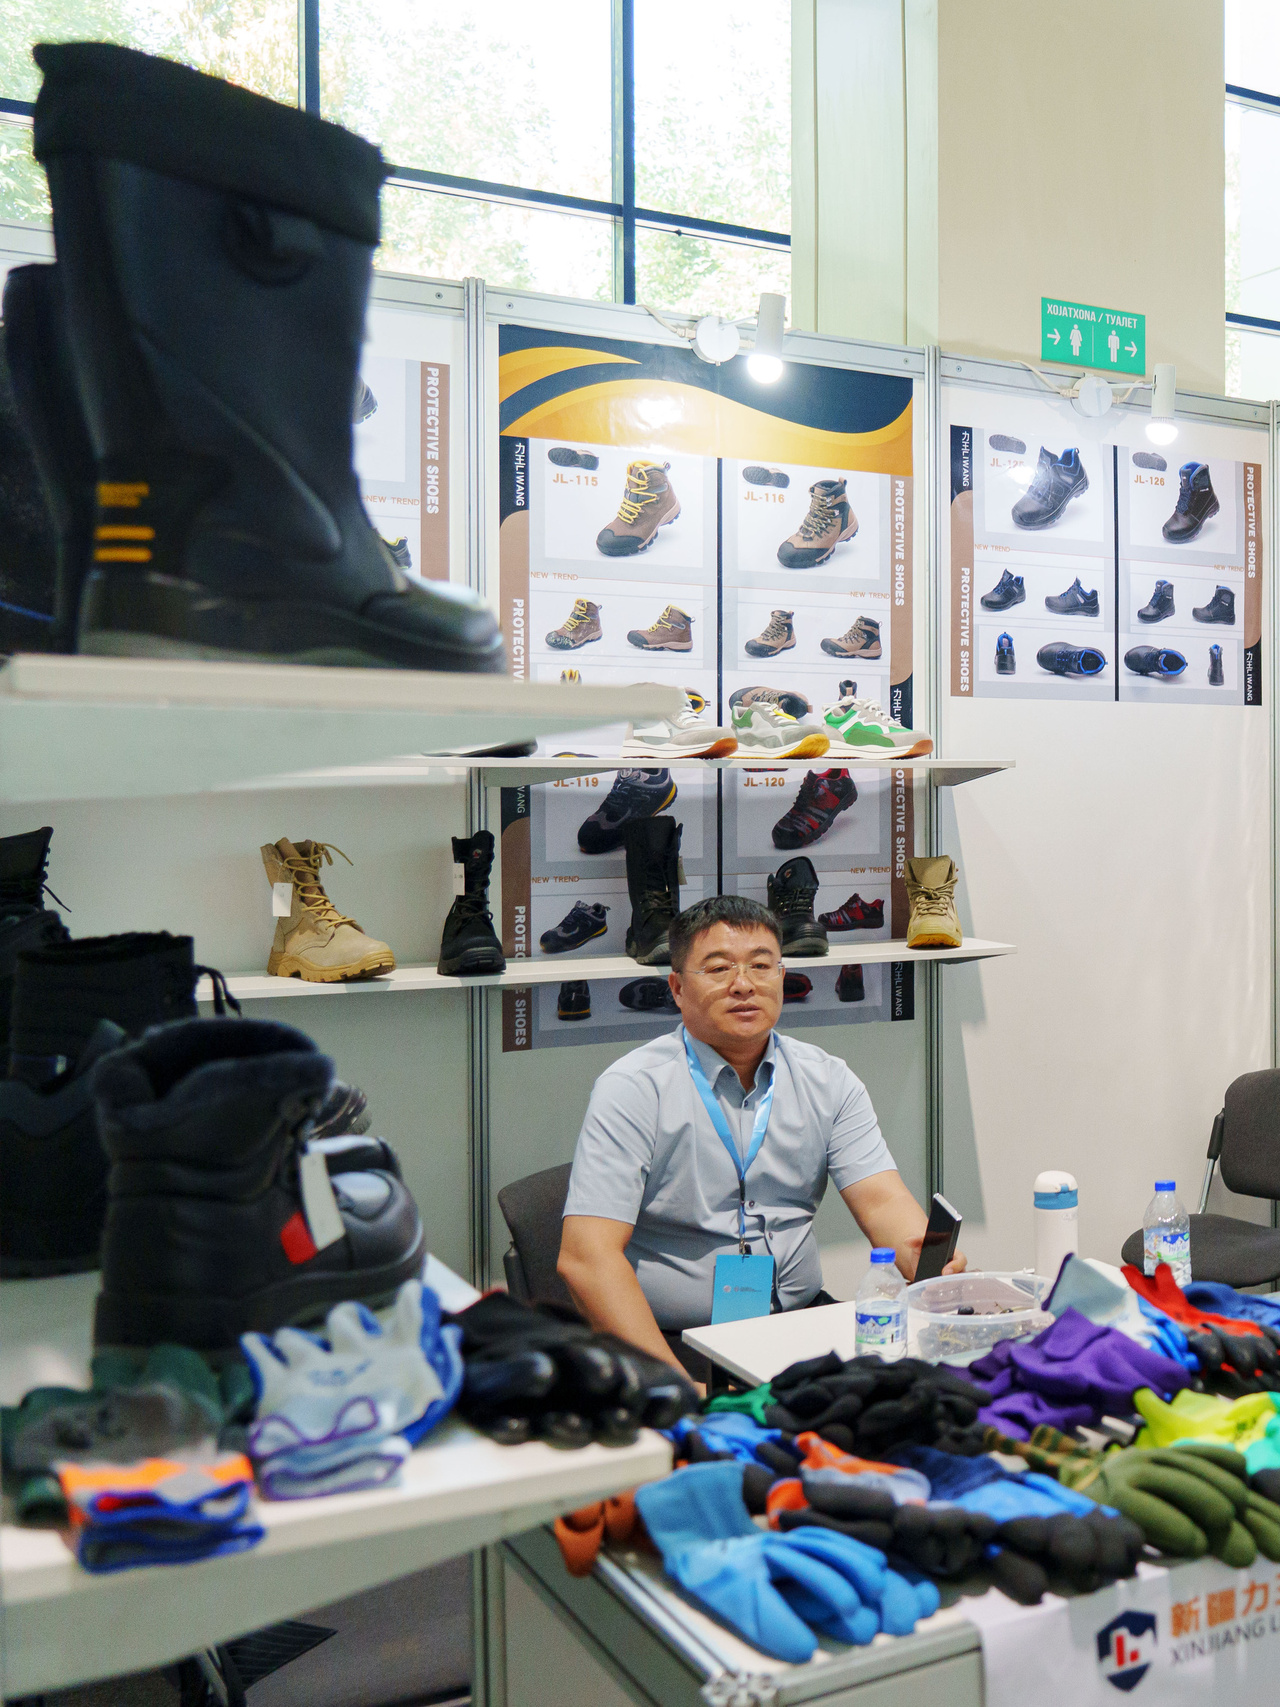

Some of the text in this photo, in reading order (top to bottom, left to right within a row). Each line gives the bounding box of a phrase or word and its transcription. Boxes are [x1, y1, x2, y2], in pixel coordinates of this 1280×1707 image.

[1105, 313, 1138, 330] ТУАЛЕТ
[426, 366, 440, 515] PROTECTIVE SHOES
[552, 473, 599, 487] JL-115
[1133, 474, 1166, 487] JL-126
[366, 495, 420, 506] NEW TREND
[743, 490, 785, 504] JL-116
[1246, 466, 1257, 579] PROTECTIVE SHOES
[895, 479, 905, 607] PROTECTIVE SHOES
[974, 543, 1011, 553] NEW TREND
[530, 571, 579, 581] NEW TREND
[850, 591, 891, 600] NEW TREND
[960, 567, 971, 692] PROTECTIVE SHOES
[553, 777, 599, 788] JL-119
[743, 777, 785, 788] JL-120
[895, 769, 906, 879] OTECTIVE SHOES
[869, 866, 891, 874] TREND
[531, 875, 580, 884] NEW TREND
[514, 999, 527, 1046] SHOES
[1171, 1616, 1266, 1667] XINJIANG
